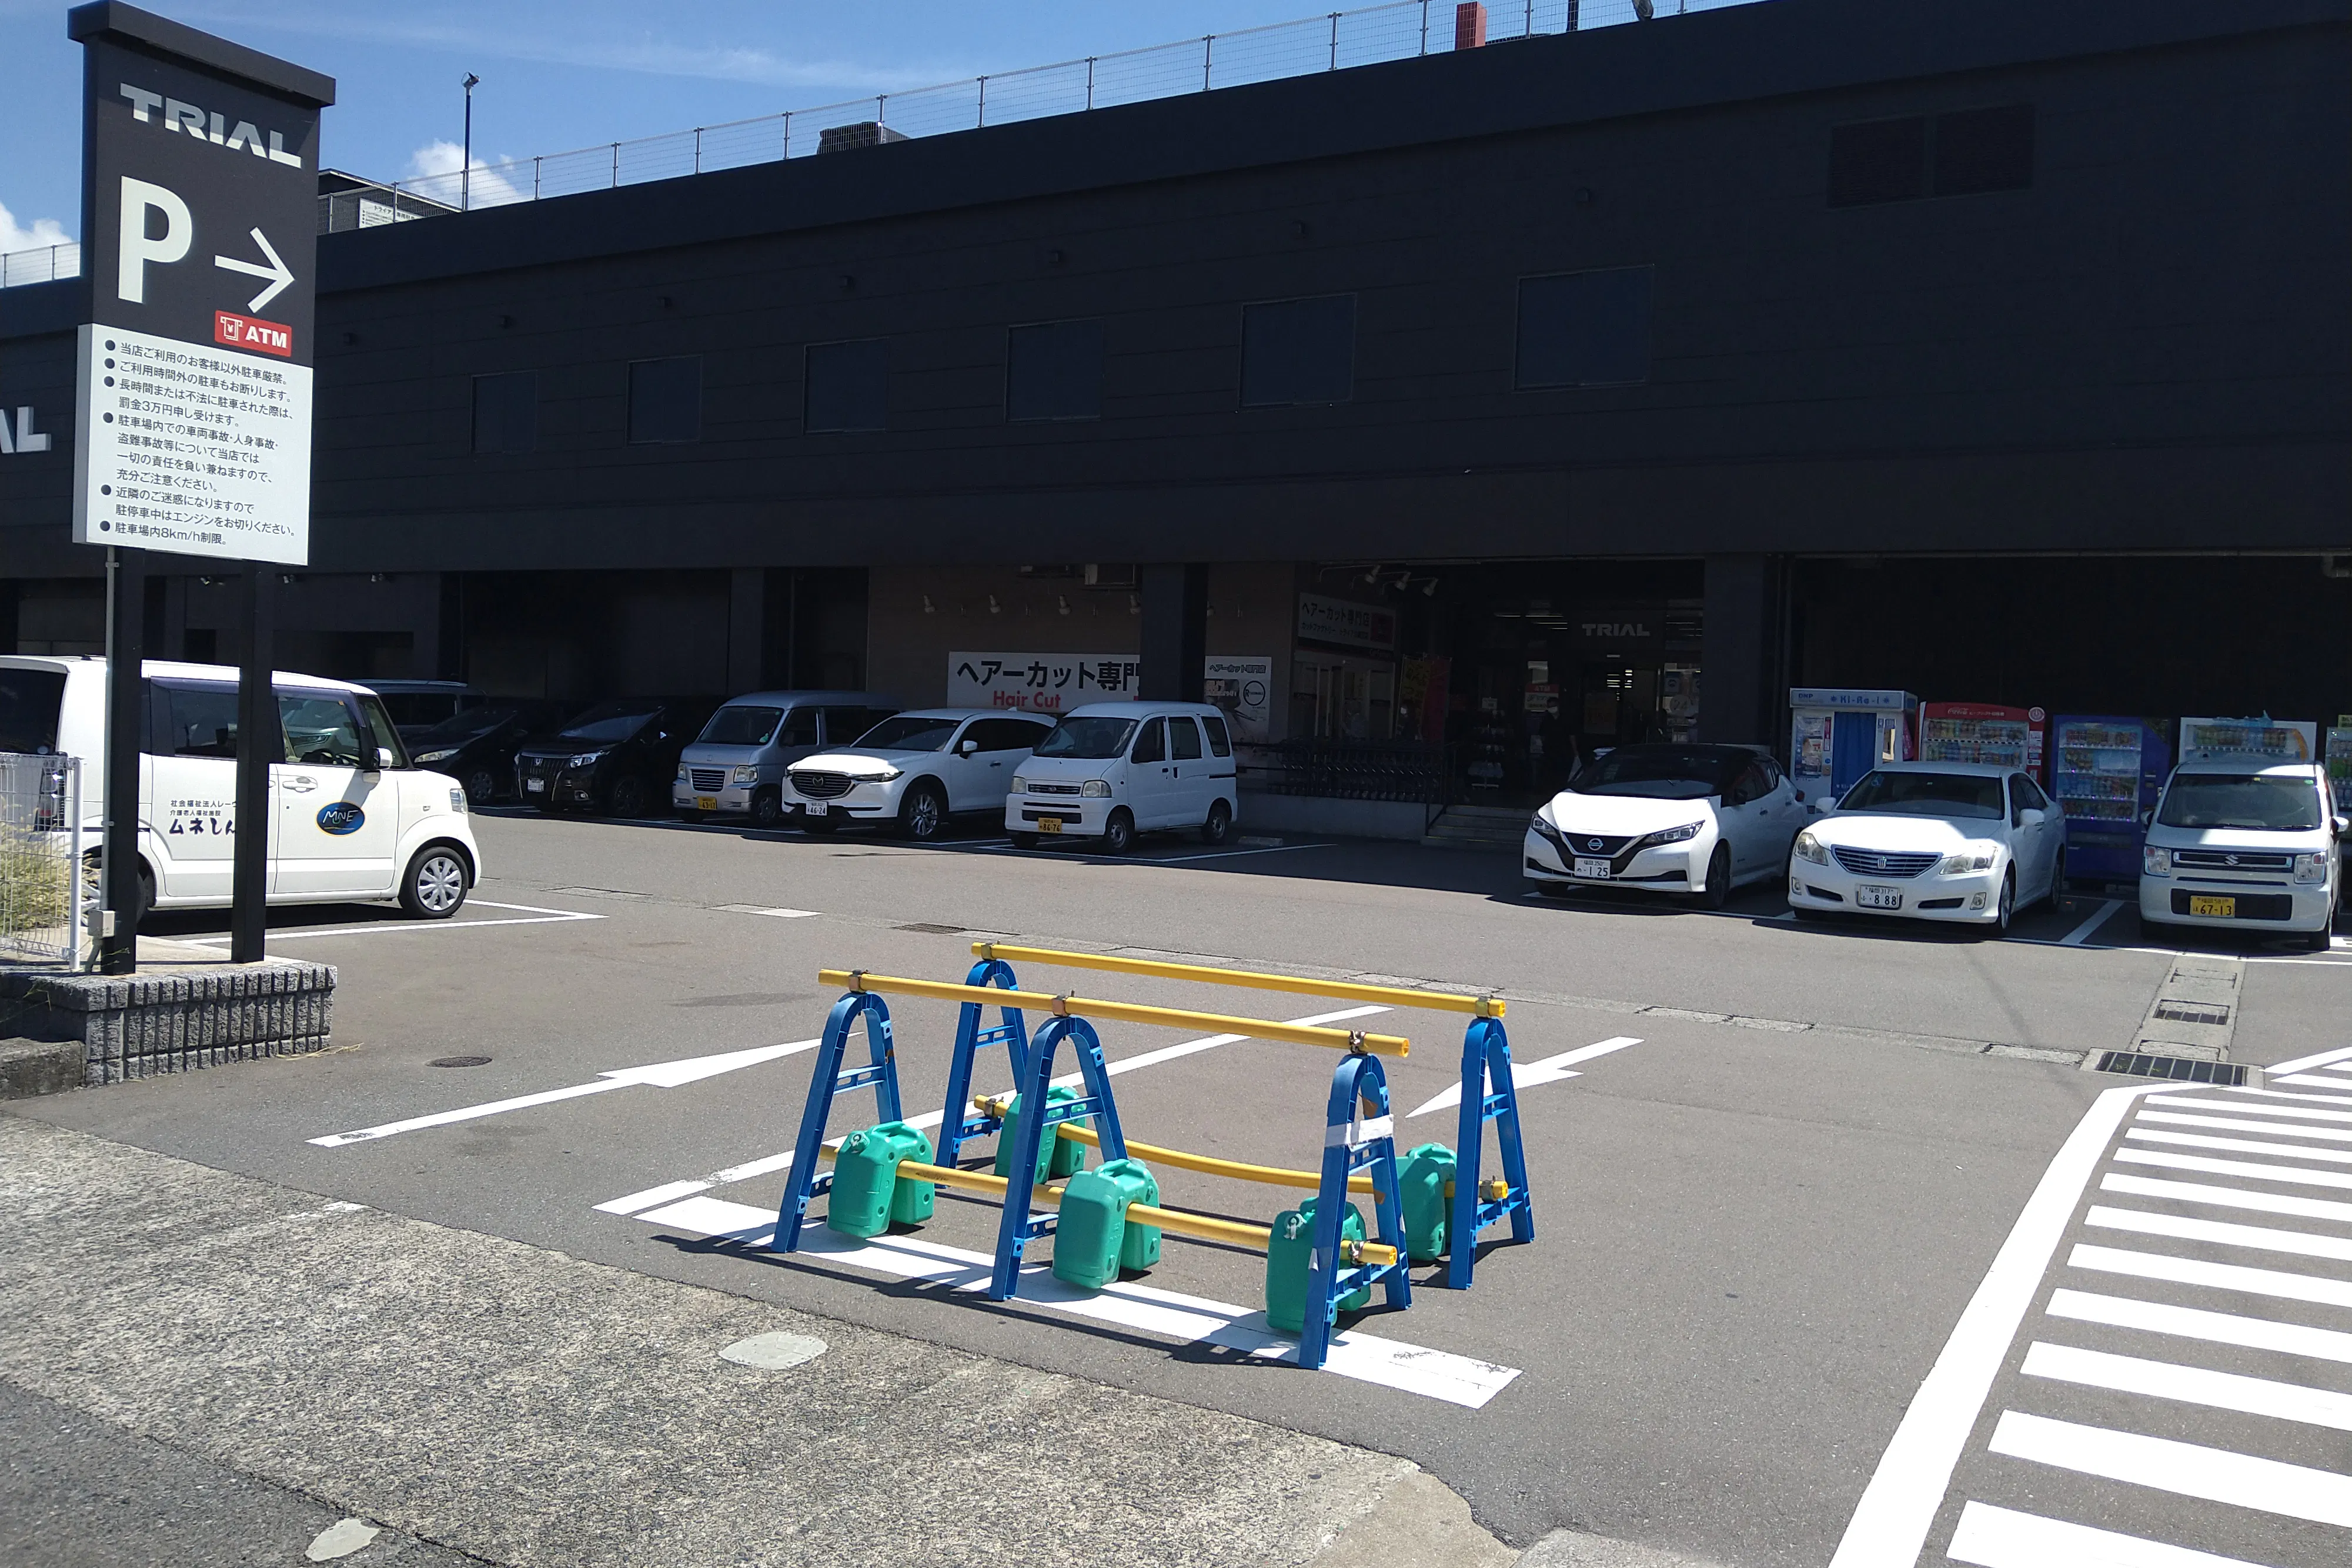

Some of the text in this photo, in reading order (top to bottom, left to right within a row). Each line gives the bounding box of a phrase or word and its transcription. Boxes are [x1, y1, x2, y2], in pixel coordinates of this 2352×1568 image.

[120, 82, 302, 168] TRIAL
[118, 175, 192, 303] P
[245, 326, 287, 349] ATM
[120, 342, 287, 385] 当店ご利用のお客様以外駐車厳禁。
[119, 360, 291, 402] ご利用時間外の駐車もお断りします。
[119, 379, 292, 419] 長時間または不法に駐車された際は、
[119, 396, 239, 427] 罰金3万円申し受けます。
[118, 433, 259, 464] 盗難事故等について当店では
[116, 469, 217, 492] 充分ご注意ください。
[117, 452, 272, 482] 一切の責任を負い兼ねますので、
[116, 487, 253, 514] 近隣のご迷惑になりますので
[116, 504, 294, 536] 駐停車中はエンジンをお切りください。
[1582, 623, 1651, 636] TRIAL
[993, 690, 1061, 708] Hair Cut
[2200, 904, 2232, 915] 67-13
